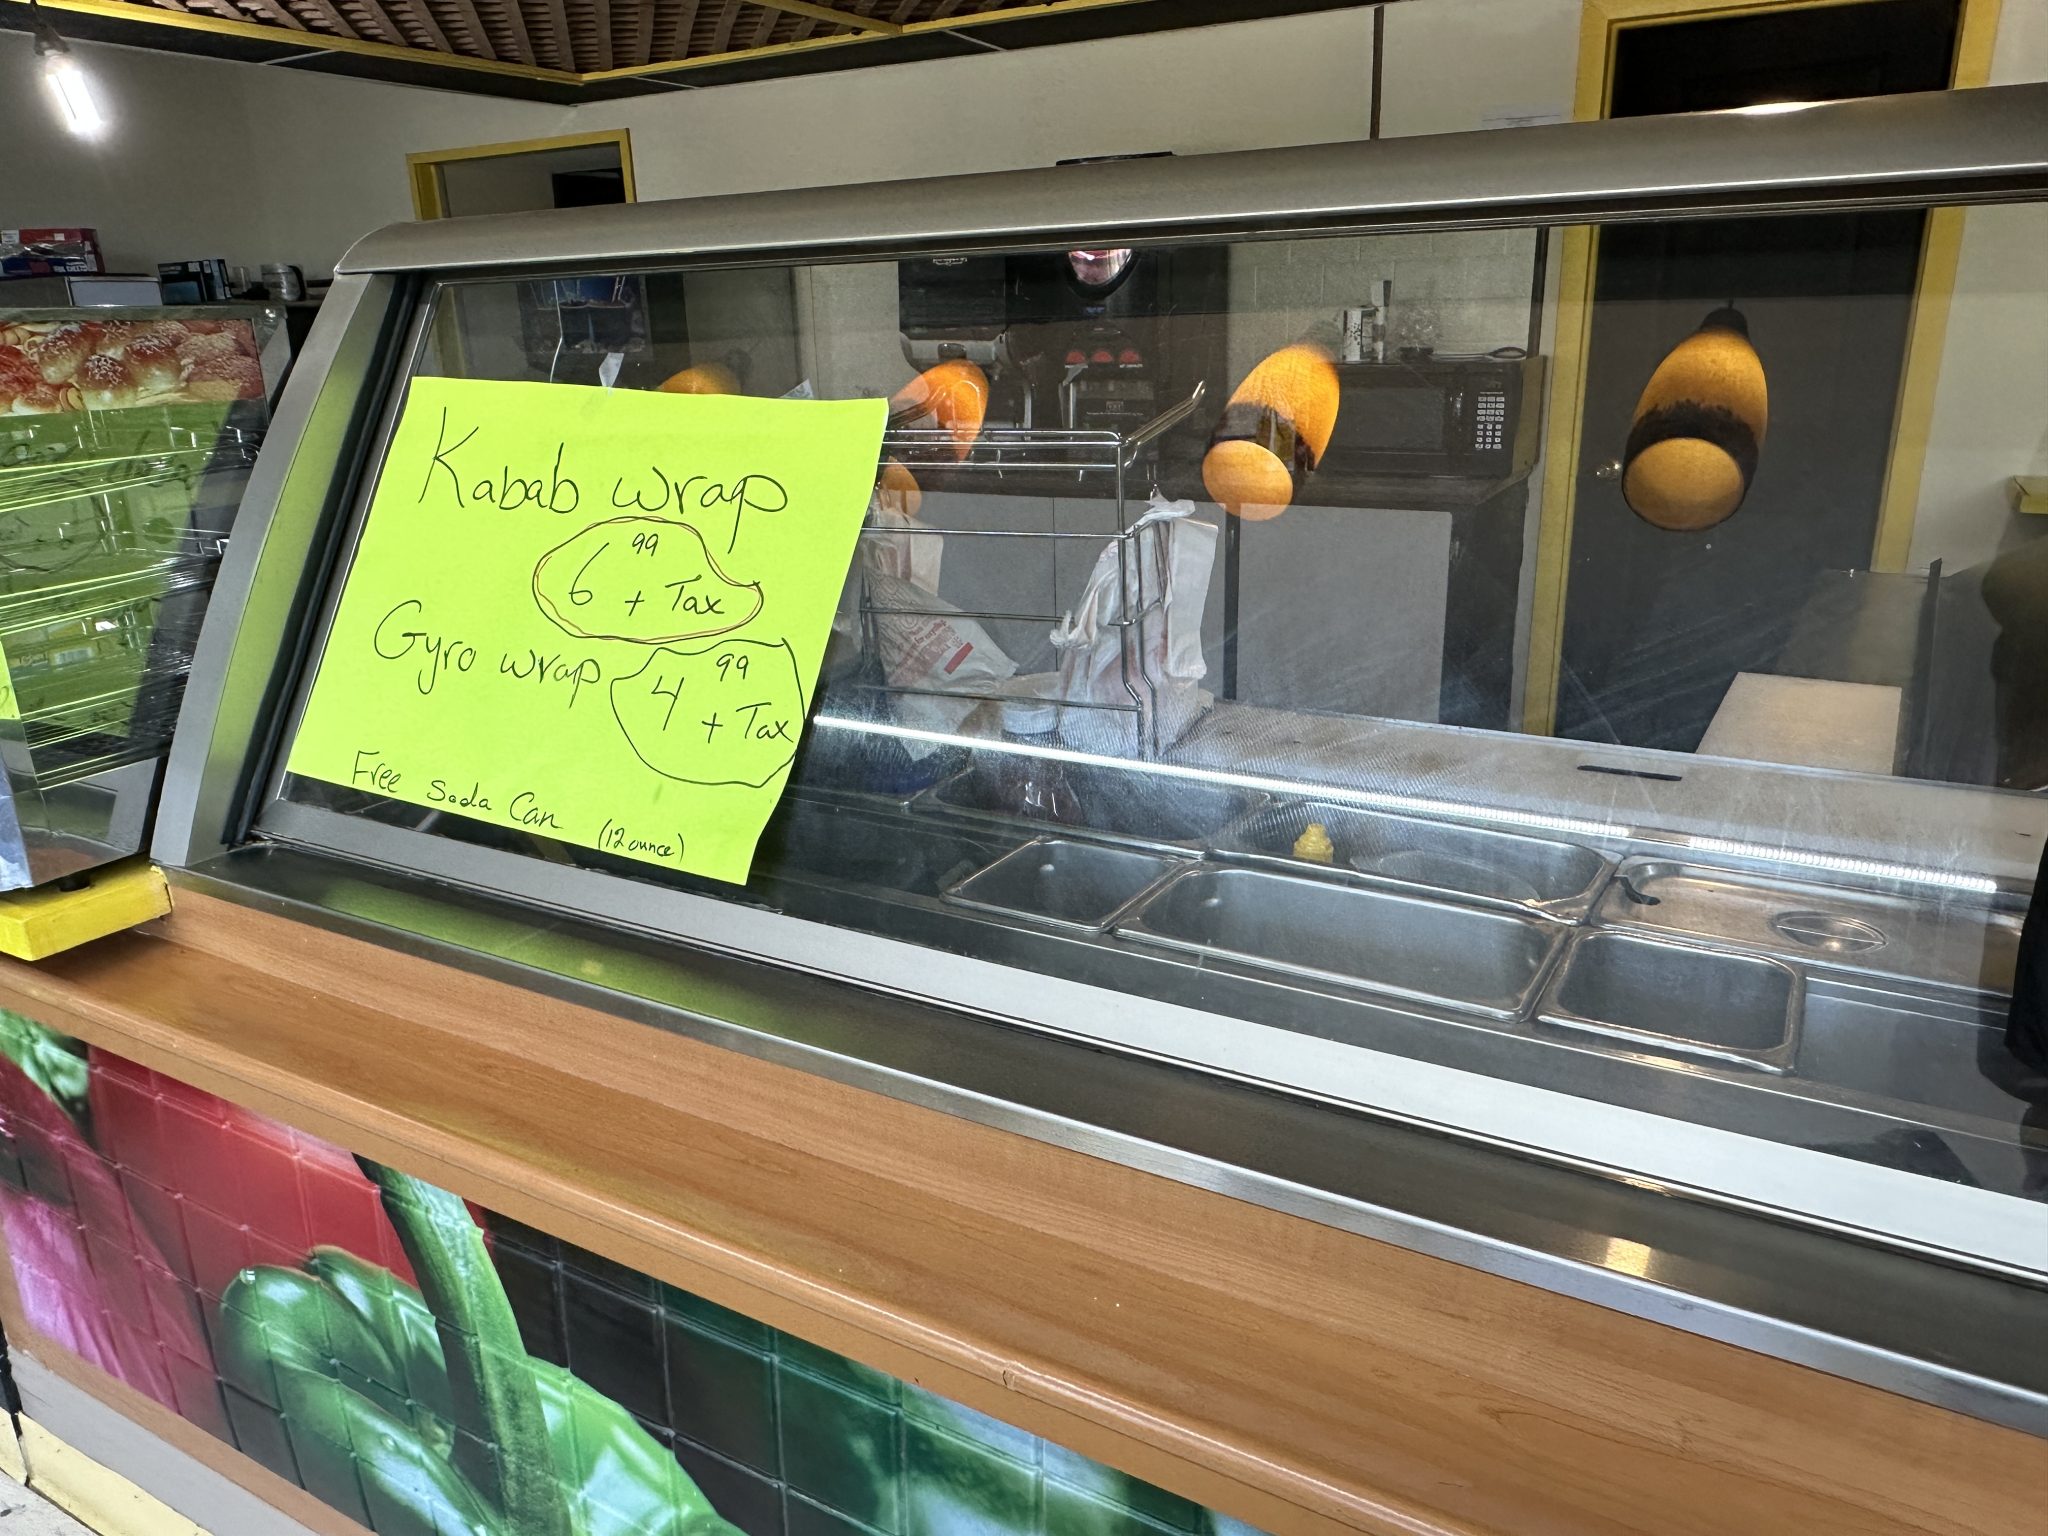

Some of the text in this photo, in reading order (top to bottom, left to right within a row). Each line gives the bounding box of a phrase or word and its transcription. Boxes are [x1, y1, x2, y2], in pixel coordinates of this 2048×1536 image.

[417, 406, 580, 515] Kabab
[665, 574, 725, 615] Tax
[373, 599, 477, 696] Gyro
[736, 701, 794, 744] Tax
[352, 749, 402, 794] Free
[510, 791, 563, 830] Can
